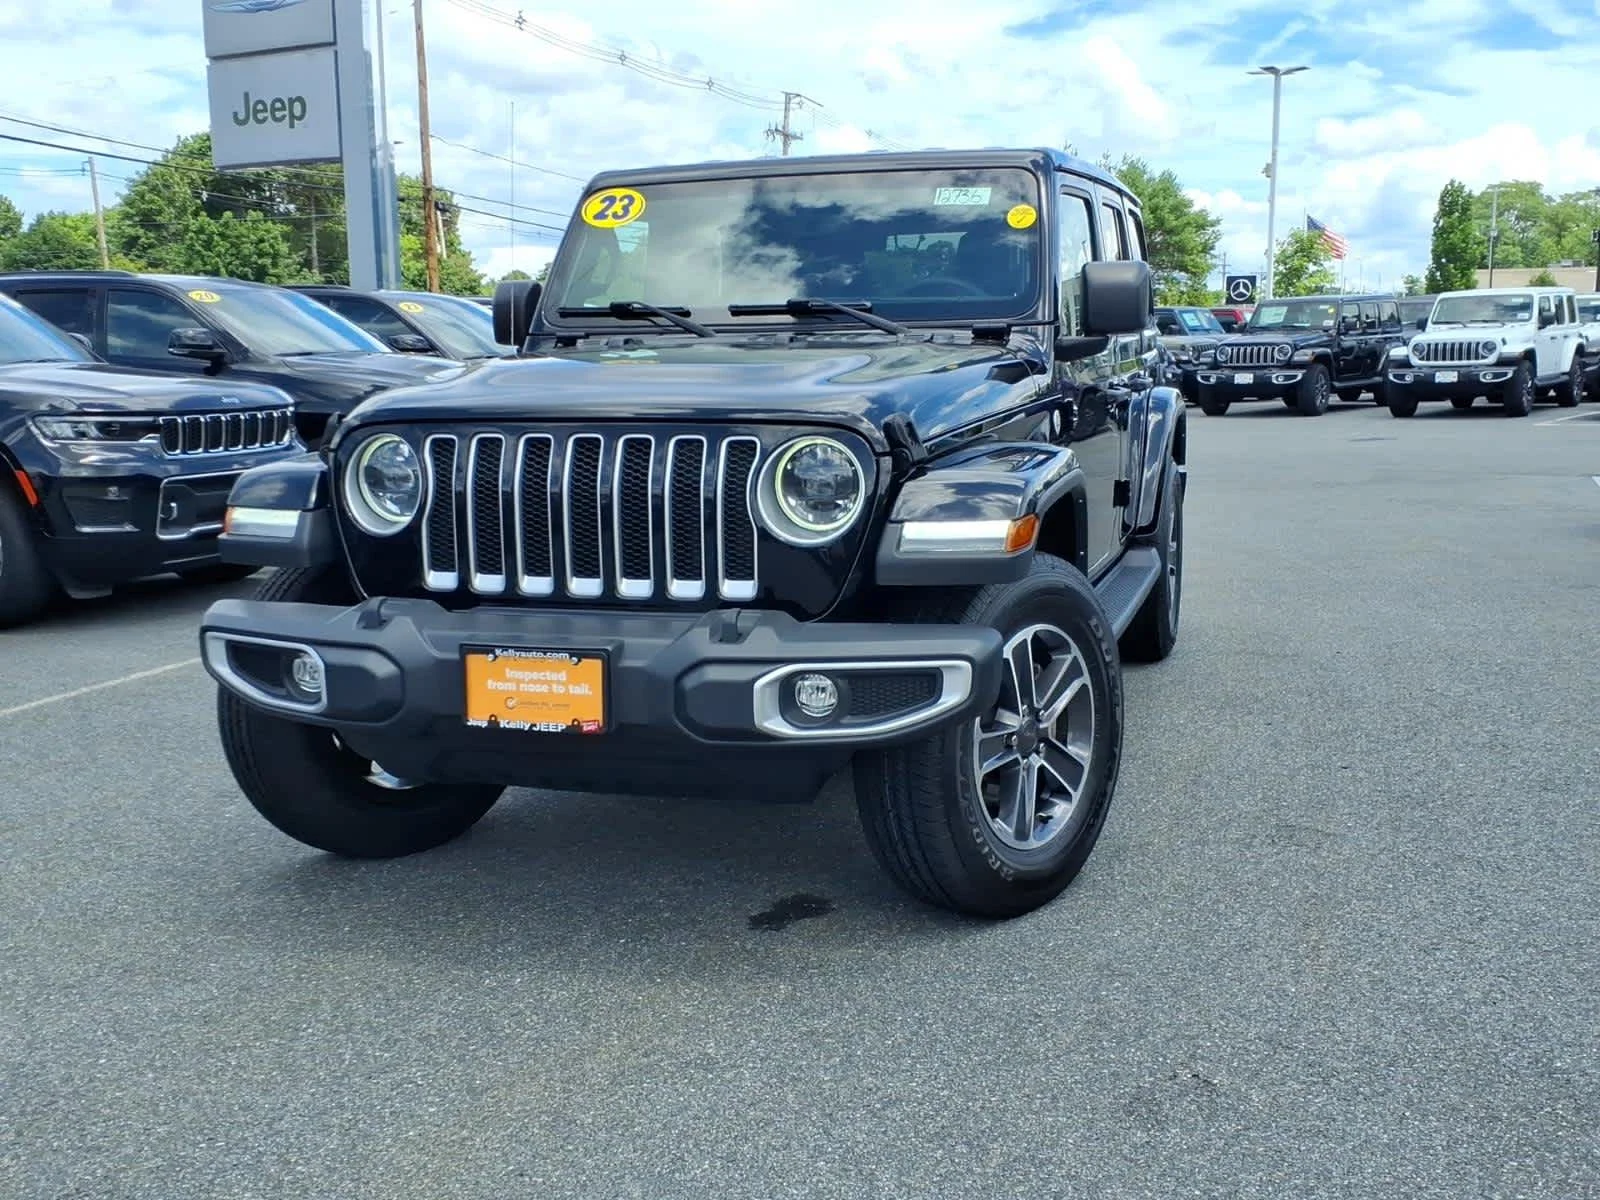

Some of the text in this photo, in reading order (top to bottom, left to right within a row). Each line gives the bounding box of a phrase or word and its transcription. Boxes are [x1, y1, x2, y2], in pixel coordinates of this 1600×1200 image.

[232, 91, 308, 129] Jeep
[592, 194, 636, 220] 23
[505, 668, 566, 681] Inspected
[487, 679, 593, 696] from nose to tail.
[500, 719, 531, 732] Kelly
[532, 722, 567, 733] JEEP
